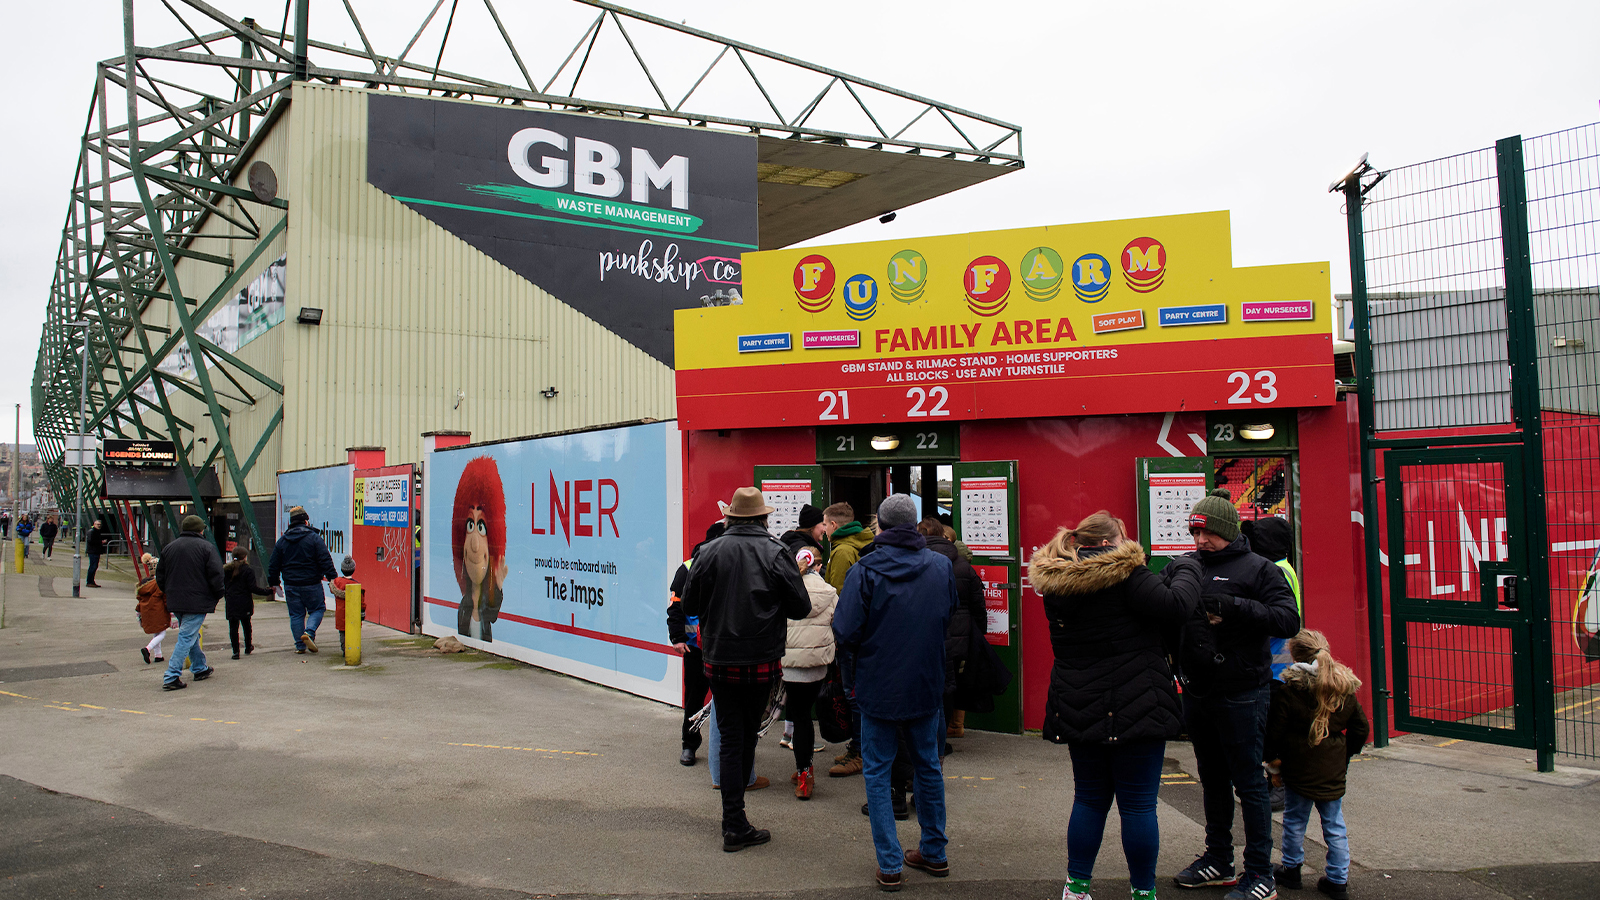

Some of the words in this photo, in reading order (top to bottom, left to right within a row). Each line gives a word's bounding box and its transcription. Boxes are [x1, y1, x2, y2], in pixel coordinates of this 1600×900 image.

[508, 127, 689, 210] GBM
[557, 198, 602, 214] WASTE
[605, 206, 691, 227] MANAGEMENT
[599, 239, 701, 290] pinkskip
[713, 261, 740, 280] co
[800, 256, 923, 305] FUN
[971, 245, 1160, 294] FARM
[1098, 318, 1116, 327] SOFT
[1118, 316, 1136, 324] PLAY
[1165, 312, 1190, 320] PARTY
[1191, 310, 1219, 318] CENTRE
[1264, 306, 1308, 314] NURSERIES
[763, 338, 785, 346] CENTRE
[820, 334, 856, 342] NURSERIES
[875, 323, 982, 353] FAMILY
[990, 317, 1077, 346] AREA
[841, 363, 866, 373] GBM
[868, 361, 903, 372] STAND
[905, 360, 914, 370] &
[916, 358, 957, 369] RILMAC
[960, 355, 997, 366] STAND
[1006, 353, 1041, 364] HOME
[1043, 349, 1118, 362] SUPPORTERS
[886, 373, 904, 383] ALL
[906, 370, 949, 381] BLOCKS
[955, 369, 977, 378] USE
[979, 367, 1003, 377] ANY
[1005, 364, 1065, 376] TURNSTILE
[818, 390, 849, 420] 21
[906, 386, 950, 417] 22
[1227, 370, 1278, 404] 23
[836, 435, 855, 451] 21
[916, 432, 939, 449] 22
[1213, 423, 1235, 442] 23
[532, 469, 620, 548] LNER
[319, 520, 344, 554] dium
[1427, 501, 1512, 596] LNE
[534, 557, 552, 569] proud
[553, 558, 560, 569] to
[560, 558, 569, 570] be
[601, 562, 617, 575] with
[544, 576, 567, 601] The
[570, 579, 604, 610] Imps
